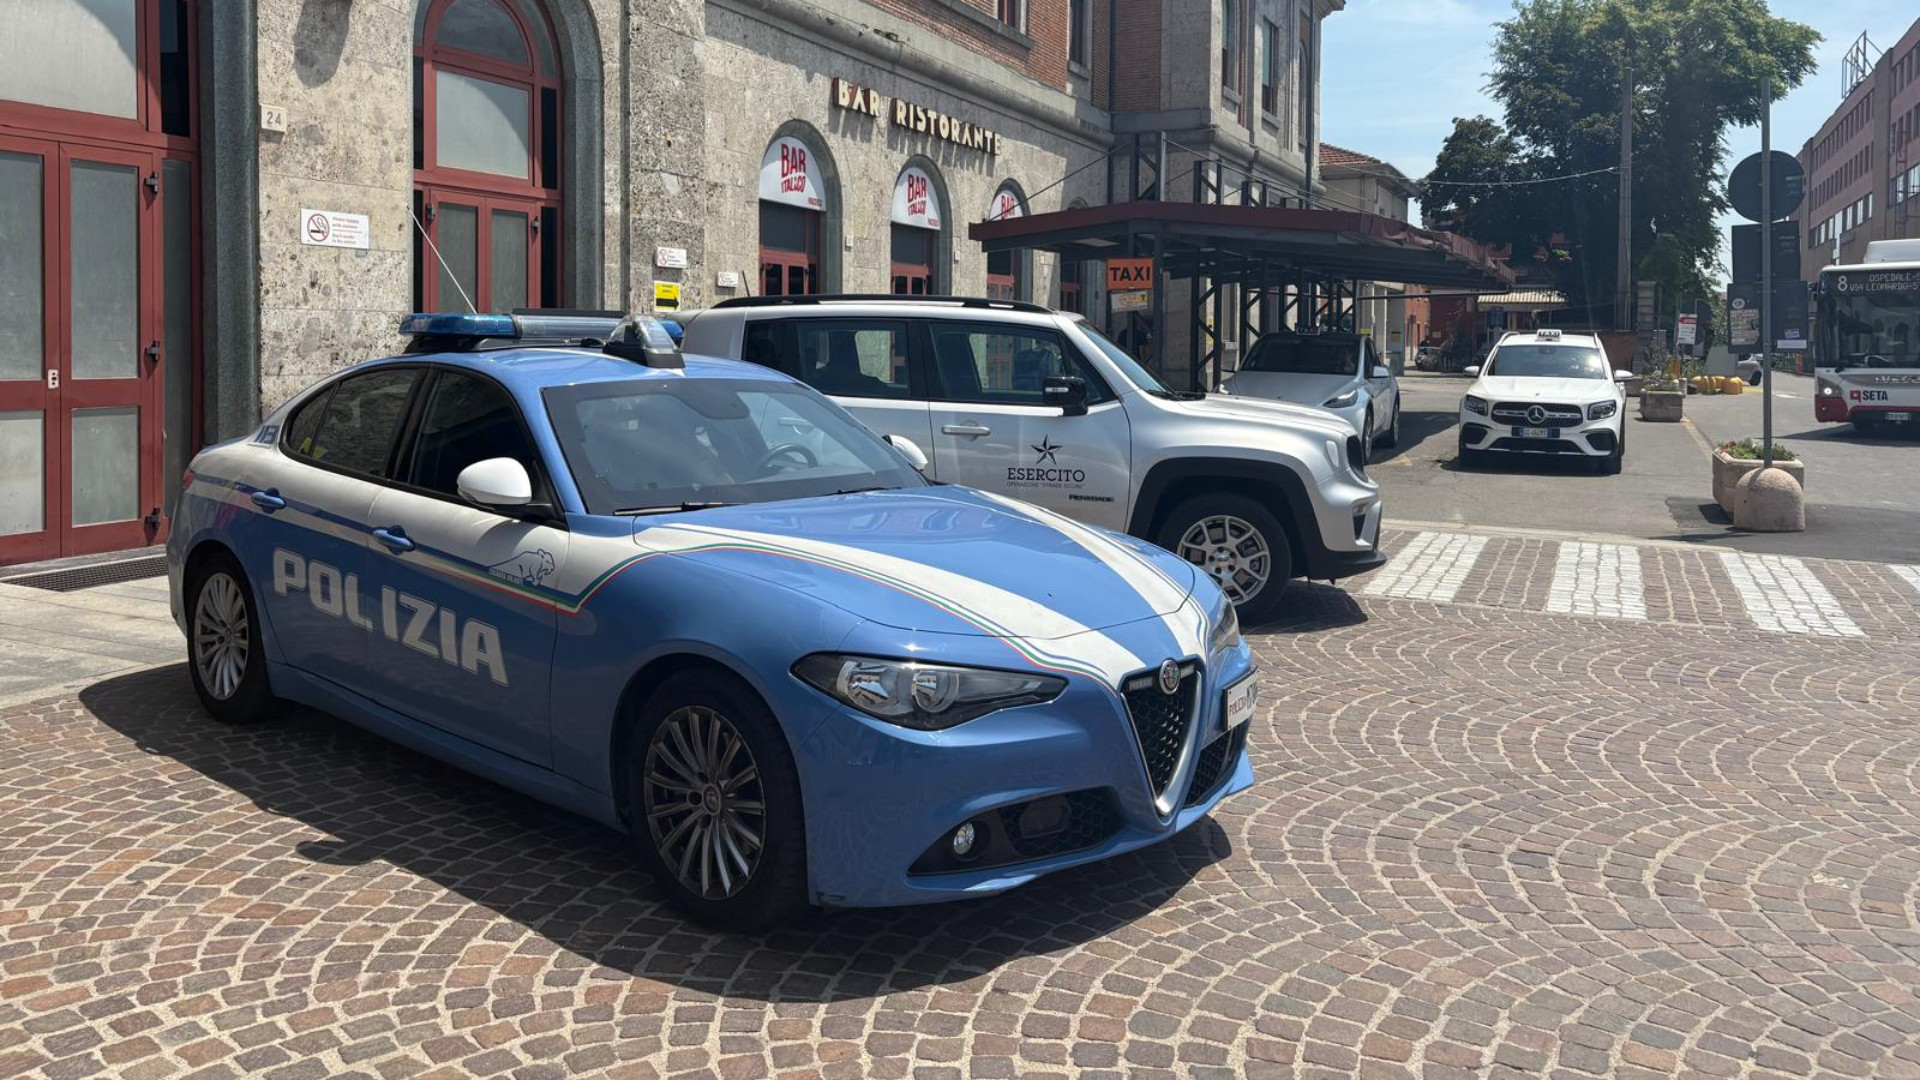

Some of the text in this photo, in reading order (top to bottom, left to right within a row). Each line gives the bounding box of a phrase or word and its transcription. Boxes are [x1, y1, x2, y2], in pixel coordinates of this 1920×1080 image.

[266, 111, 282, 125] 24
[837, 79, 1002, 157] BAR RISTORANTE
[781, 143, 806, 178] BAR
[908, 173, 927, 203] BAR
[1001, 194, 1015, 221] BAR
[1109, 266, 1151, 282] TAXI
[1837, 275, 1848, 292] 8
[1862, 390, 1889, 401] SETA
[1007, 467, 1085, 482] ESERCITO
[272, 547, 509, 687] POLIZIA
